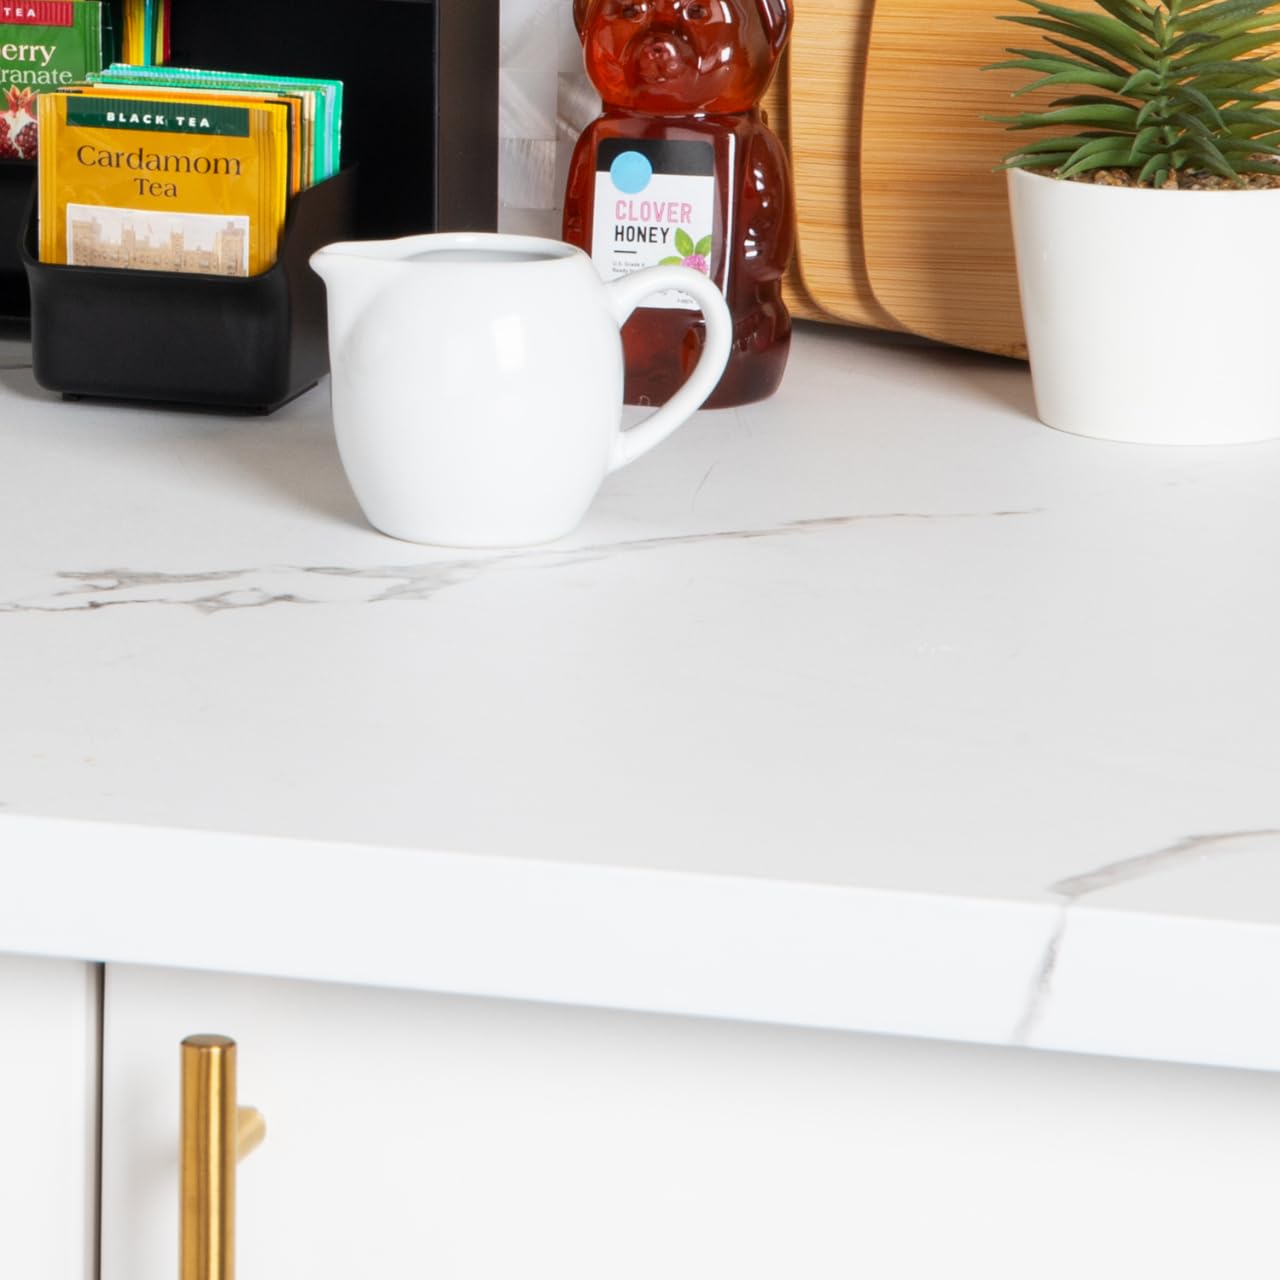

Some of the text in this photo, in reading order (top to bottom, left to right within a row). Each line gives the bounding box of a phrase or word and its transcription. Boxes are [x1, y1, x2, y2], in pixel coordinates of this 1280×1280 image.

[3, 7, 37, 18] TEA
[106, 111, 210, 128] BLACK TEA
[76, 145, 242, 176] Cardamom
[133, 178, 178, 198] Tea
[614, 199, 693, 224] CLOVER
[614, 225, 670, 244] HONEY
